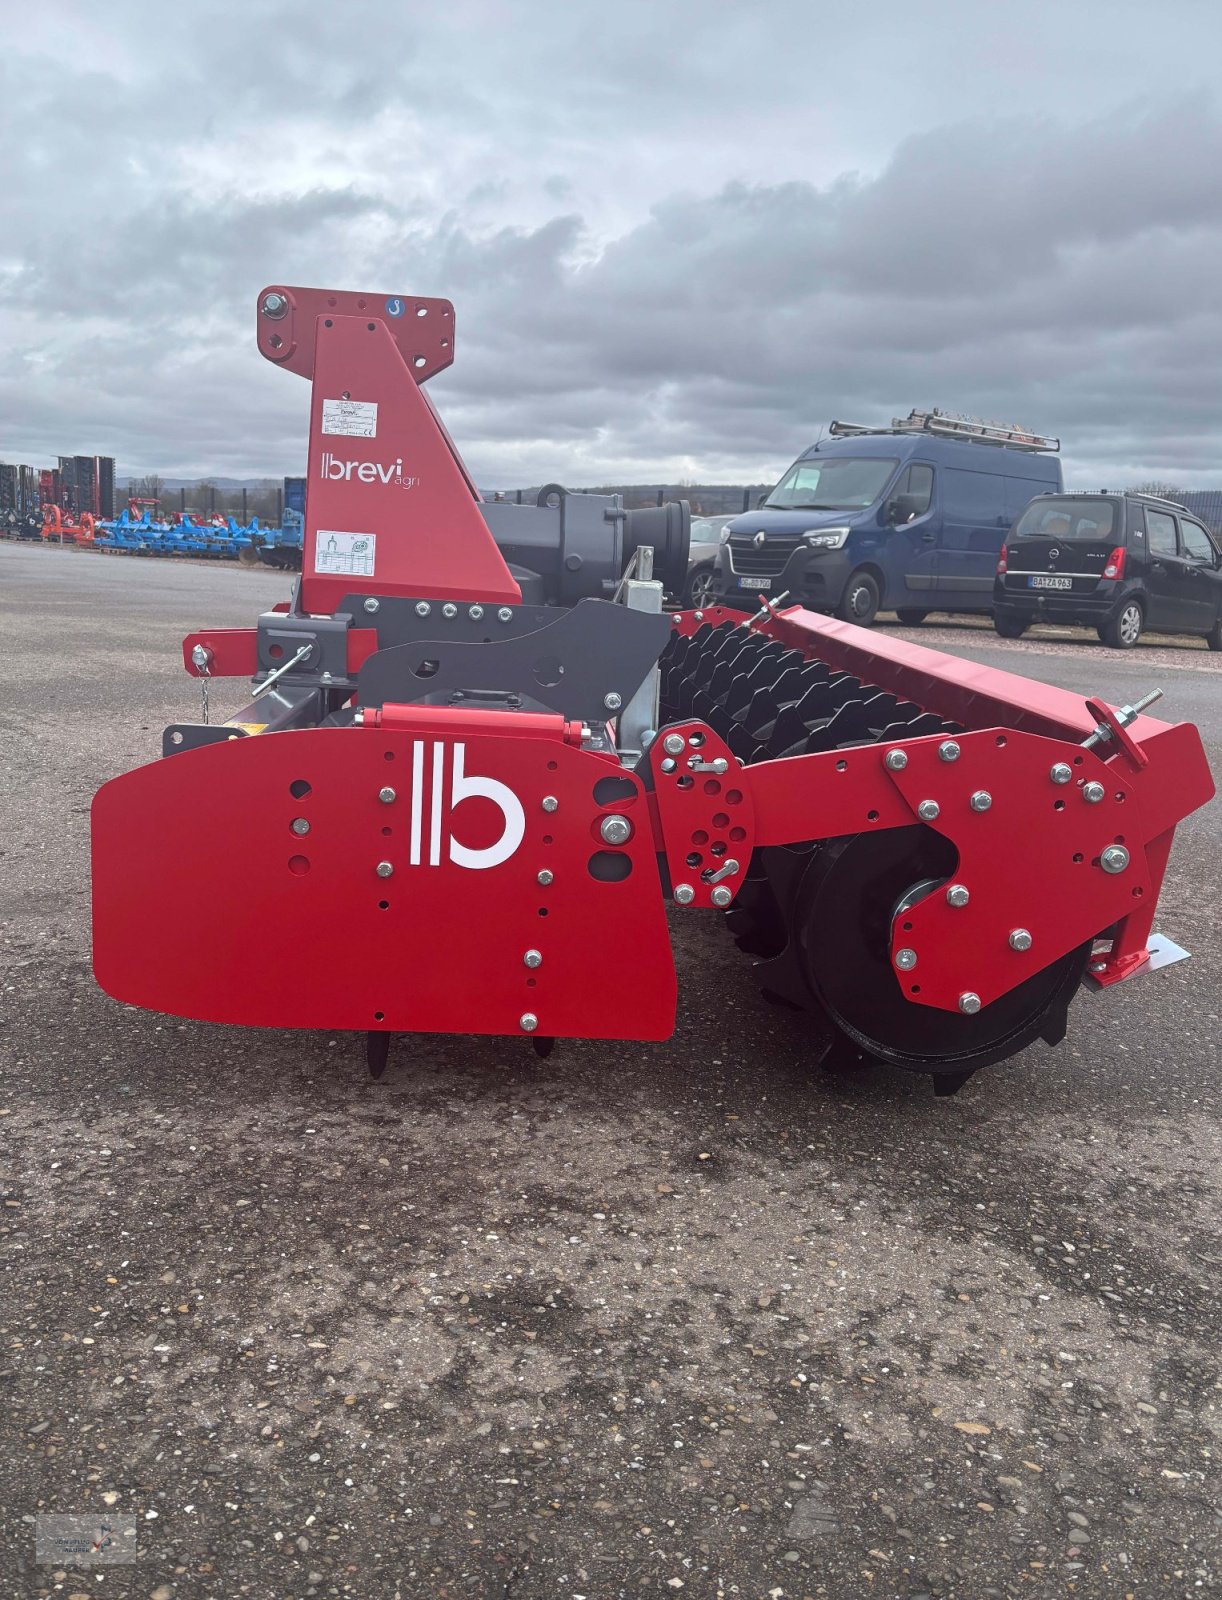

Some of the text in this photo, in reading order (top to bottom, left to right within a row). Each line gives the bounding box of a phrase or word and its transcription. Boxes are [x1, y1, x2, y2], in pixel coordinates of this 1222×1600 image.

[394, 476, 420, 490] agri
[1033, 577, 1071, 588] BA ZA 963
